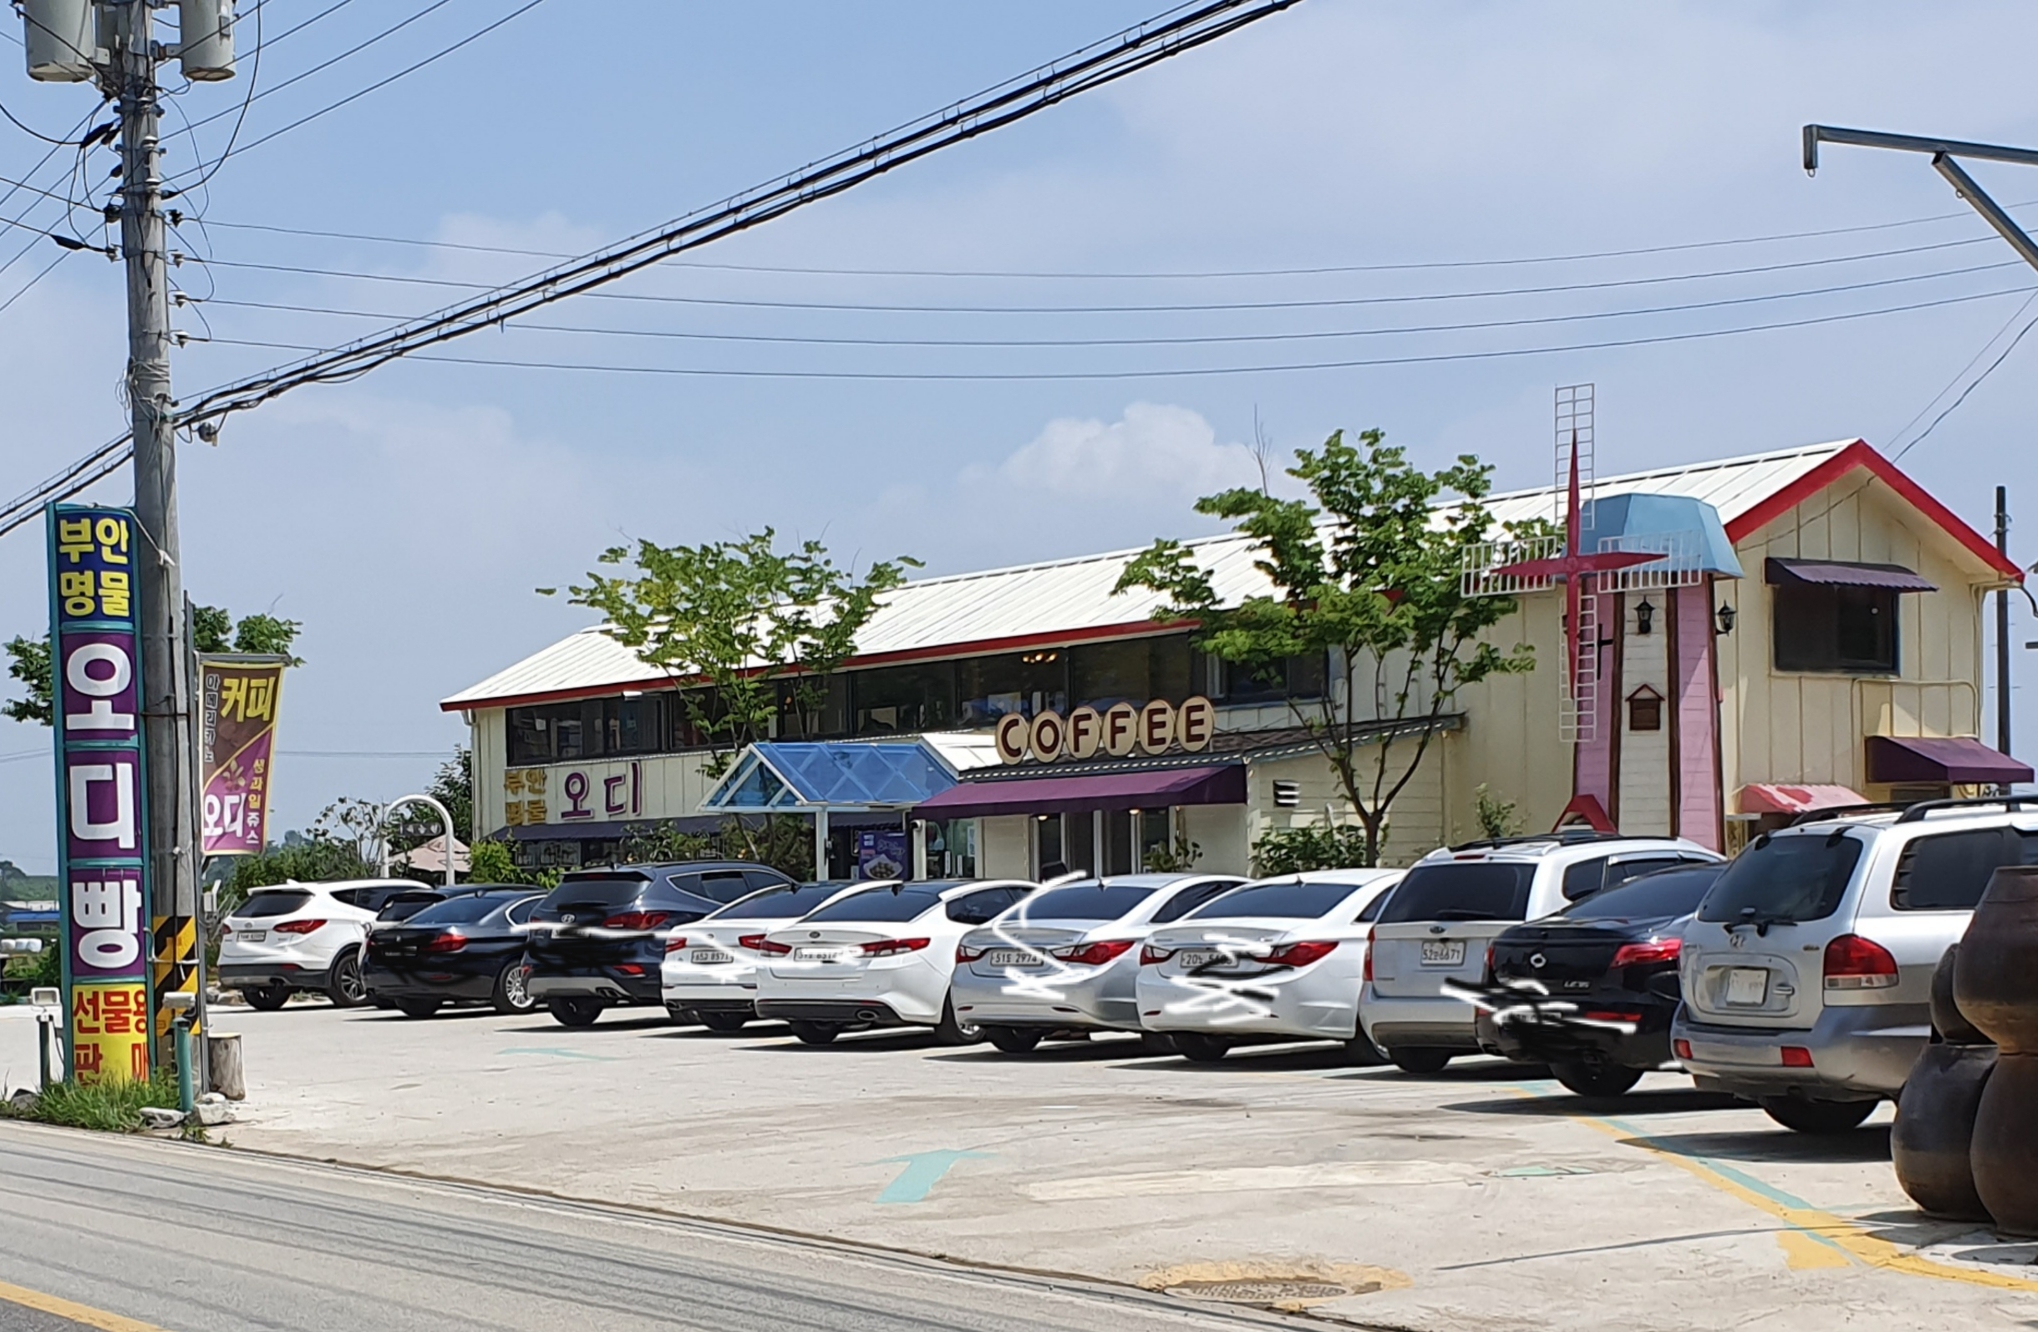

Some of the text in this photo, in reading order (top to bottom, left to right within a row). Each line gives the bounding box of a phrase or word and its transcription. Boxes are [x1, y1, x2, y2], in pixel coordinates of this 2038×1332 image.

[59, 517, 130, 565] 부안
[60, 570, 131, 618] 명물
[220, 676, 277, 723] 커피
[1001, 704, 1206, 758] COFFEE
[66, 642, 143, 969] 오디빵
[504, 769, 547, 795] 부안
[561, 761, 643, 820] 오디
[204, 792, 247, 838] 오디
[505, 800, 547, 826] 명물
[74, 990, 147, 1034] 선물용
